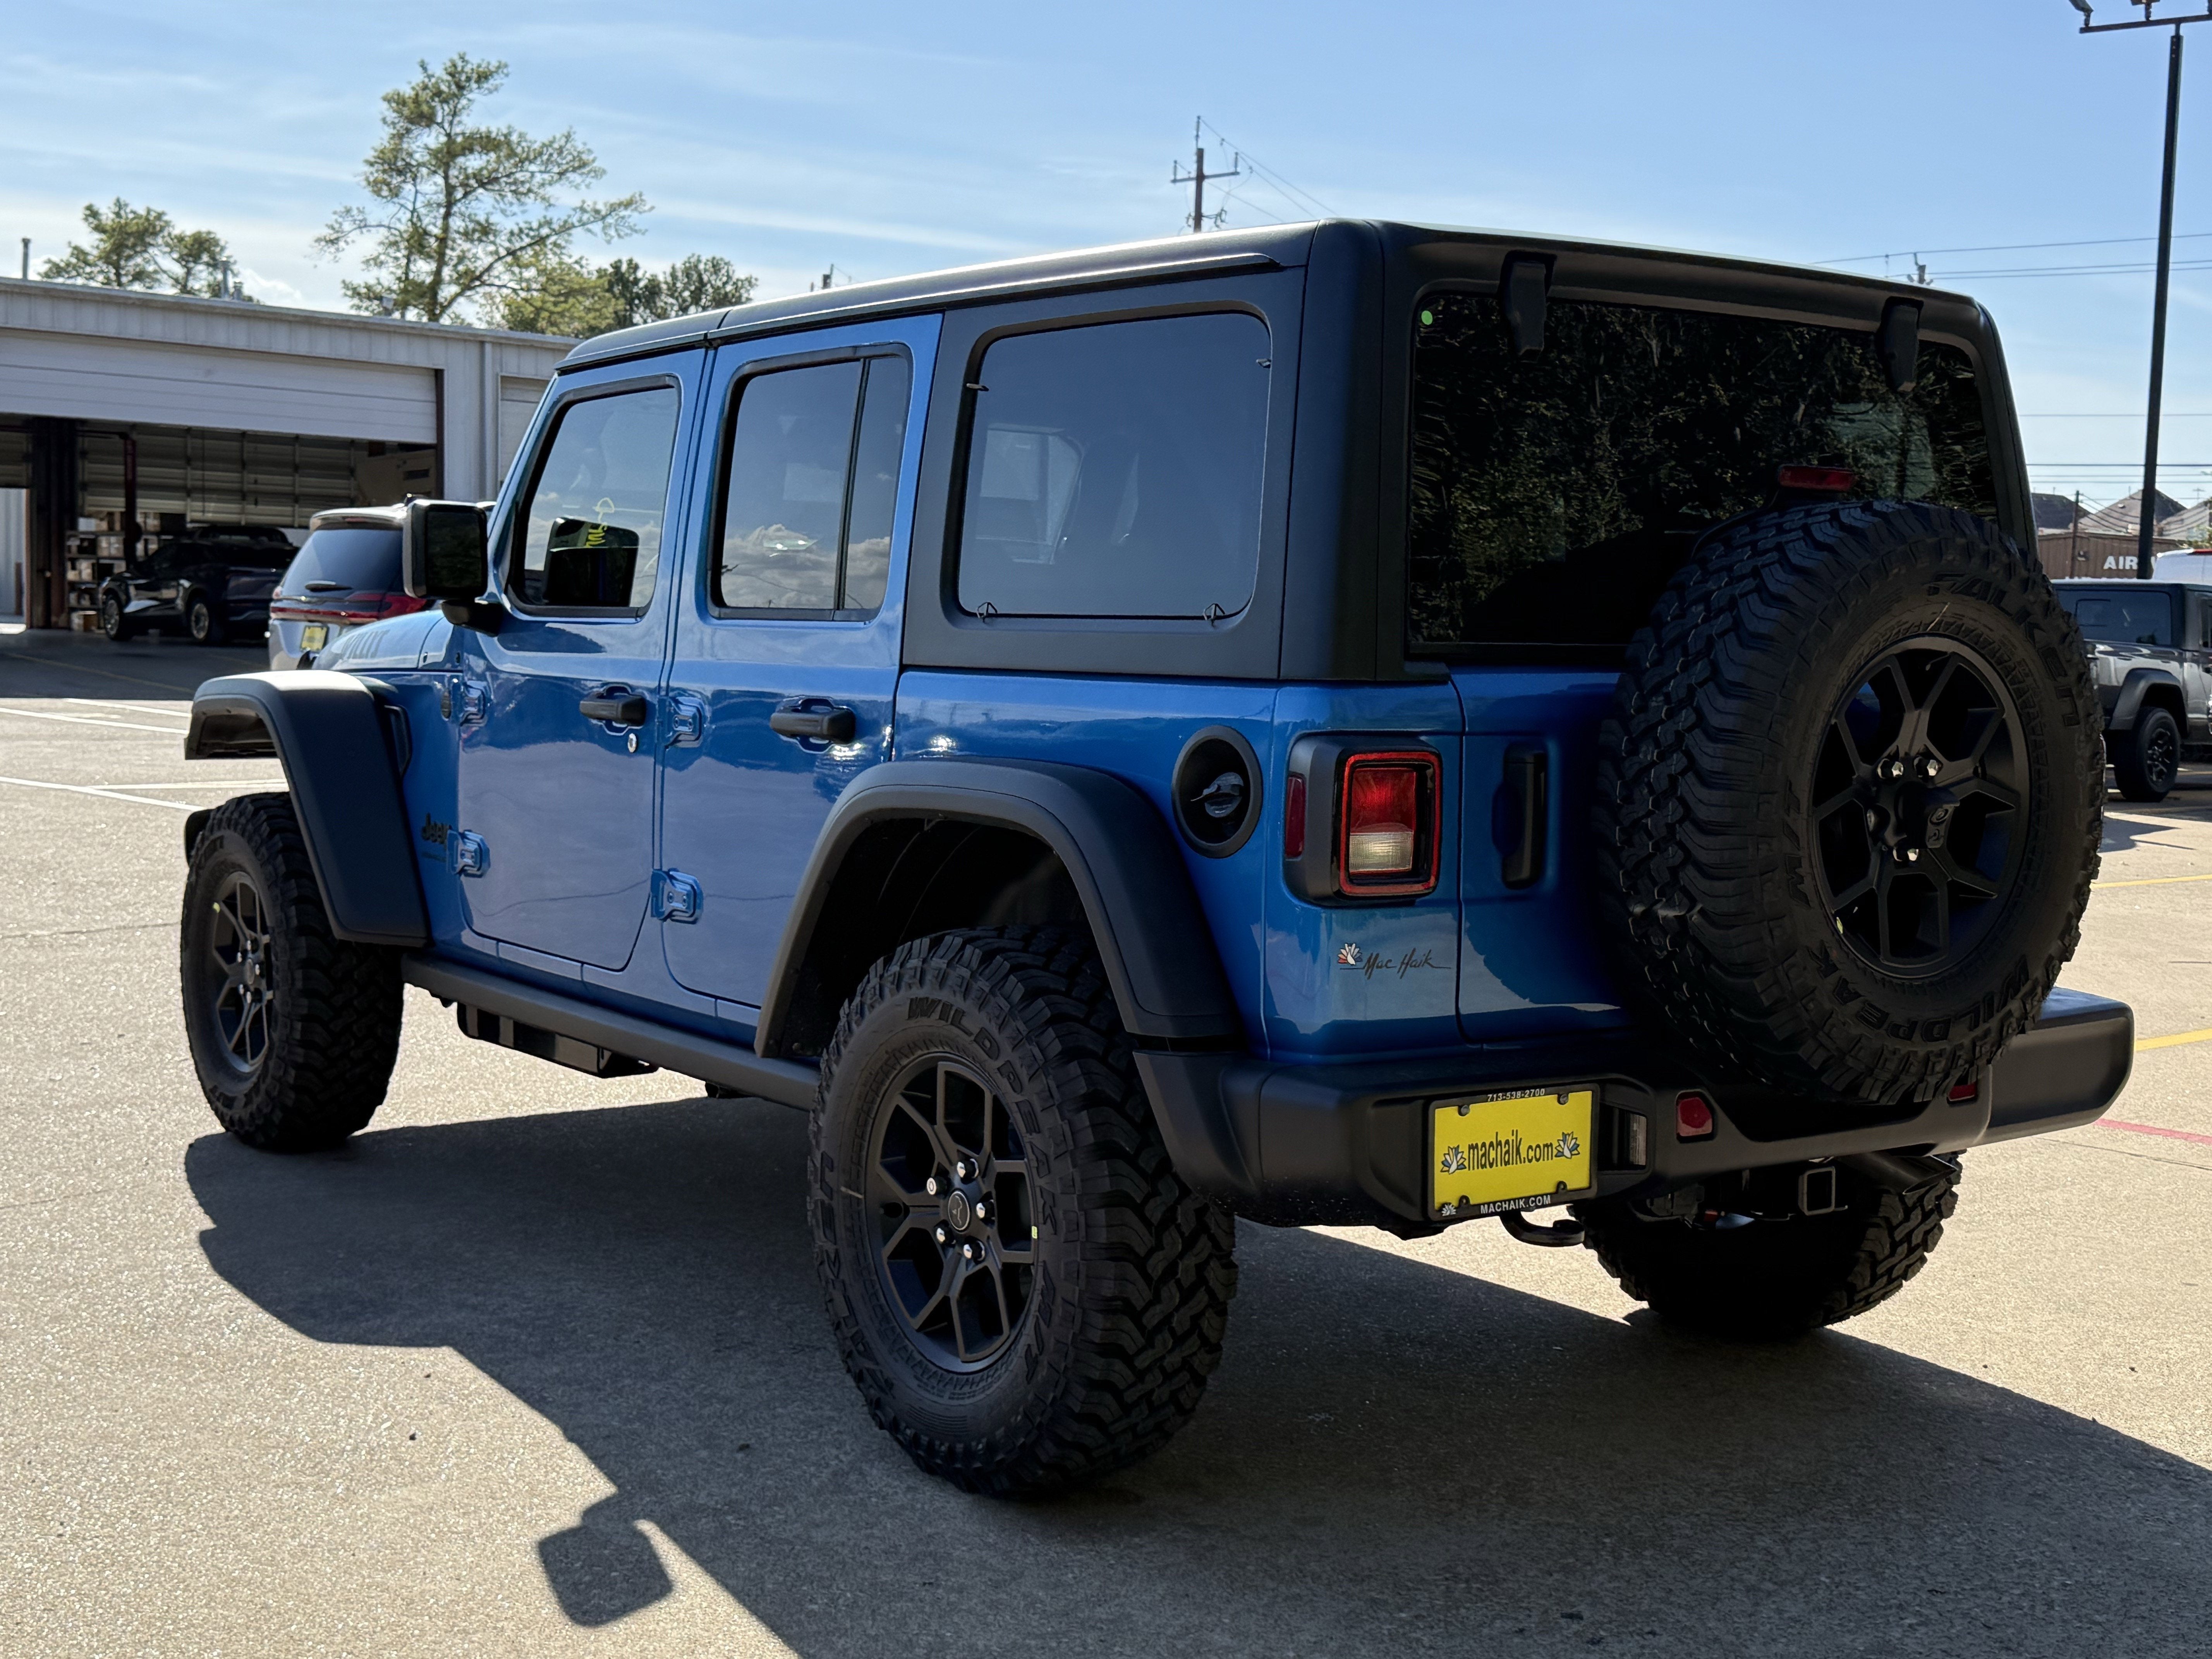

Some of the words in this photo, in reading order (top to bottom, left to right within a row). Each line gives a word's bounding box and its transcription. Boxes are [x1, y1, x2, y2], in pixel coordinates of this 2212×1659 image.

[1364, 953, 1396, 979] Mac
[1397, 948, 1436, 979] Haik
[906, 996, 1057, 1235] WILDPEAK
[1468, 1130, 1553, 1171] machaik.com
[1480, 1195, 1551, 1214] MACHAIK.COM
